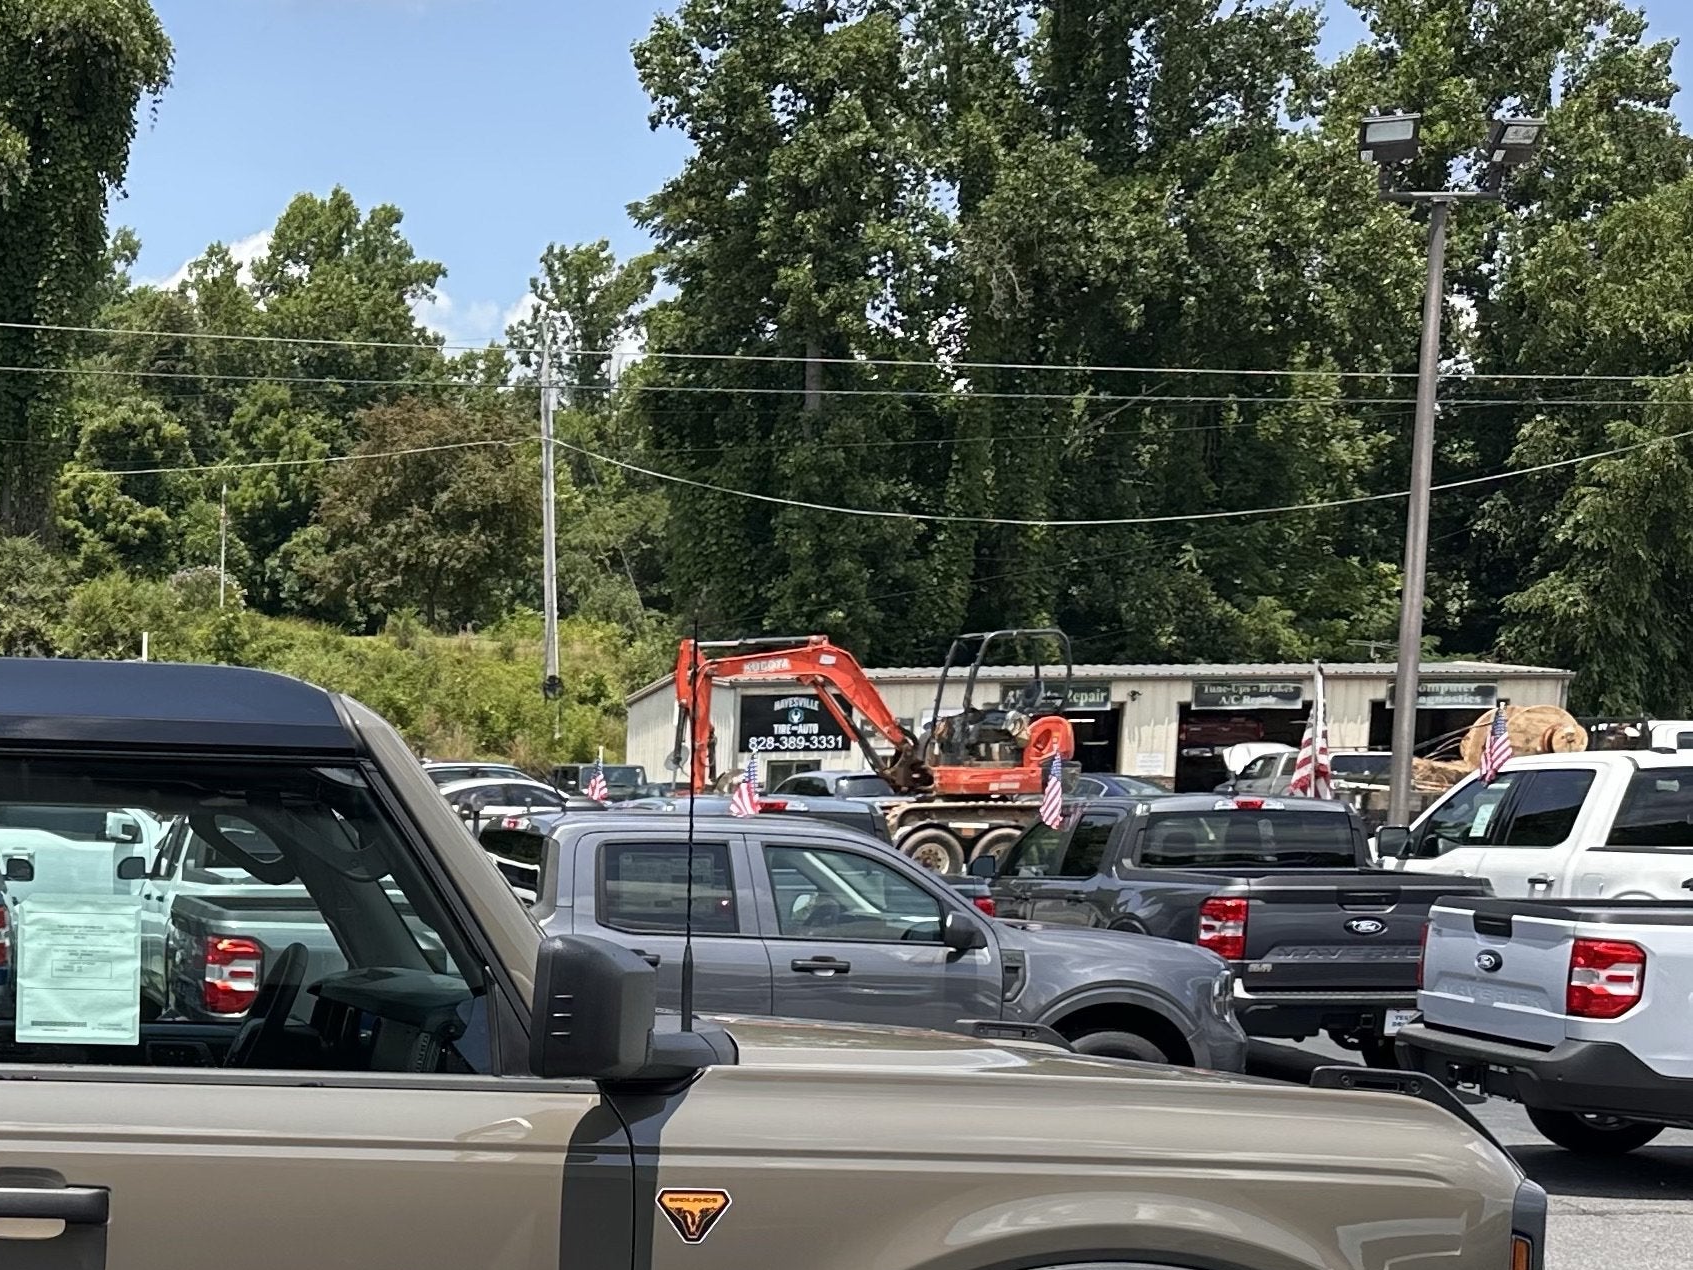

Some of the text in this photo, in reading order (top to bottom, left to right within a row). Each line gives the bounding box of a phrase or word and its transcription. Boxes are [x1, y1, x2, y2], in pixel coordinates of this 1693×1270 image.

[1418, 684, 1476, 695] omputer
[773, 697, 819, 711] HAYESVILLE
[1219, 695, 1241, 705] A/C
[773, 723, 819, 734] TIRE AUTO
[748, 735, 843, 750] 828-389-3331
[1274, 949, 1421, 959] MAVERIC
